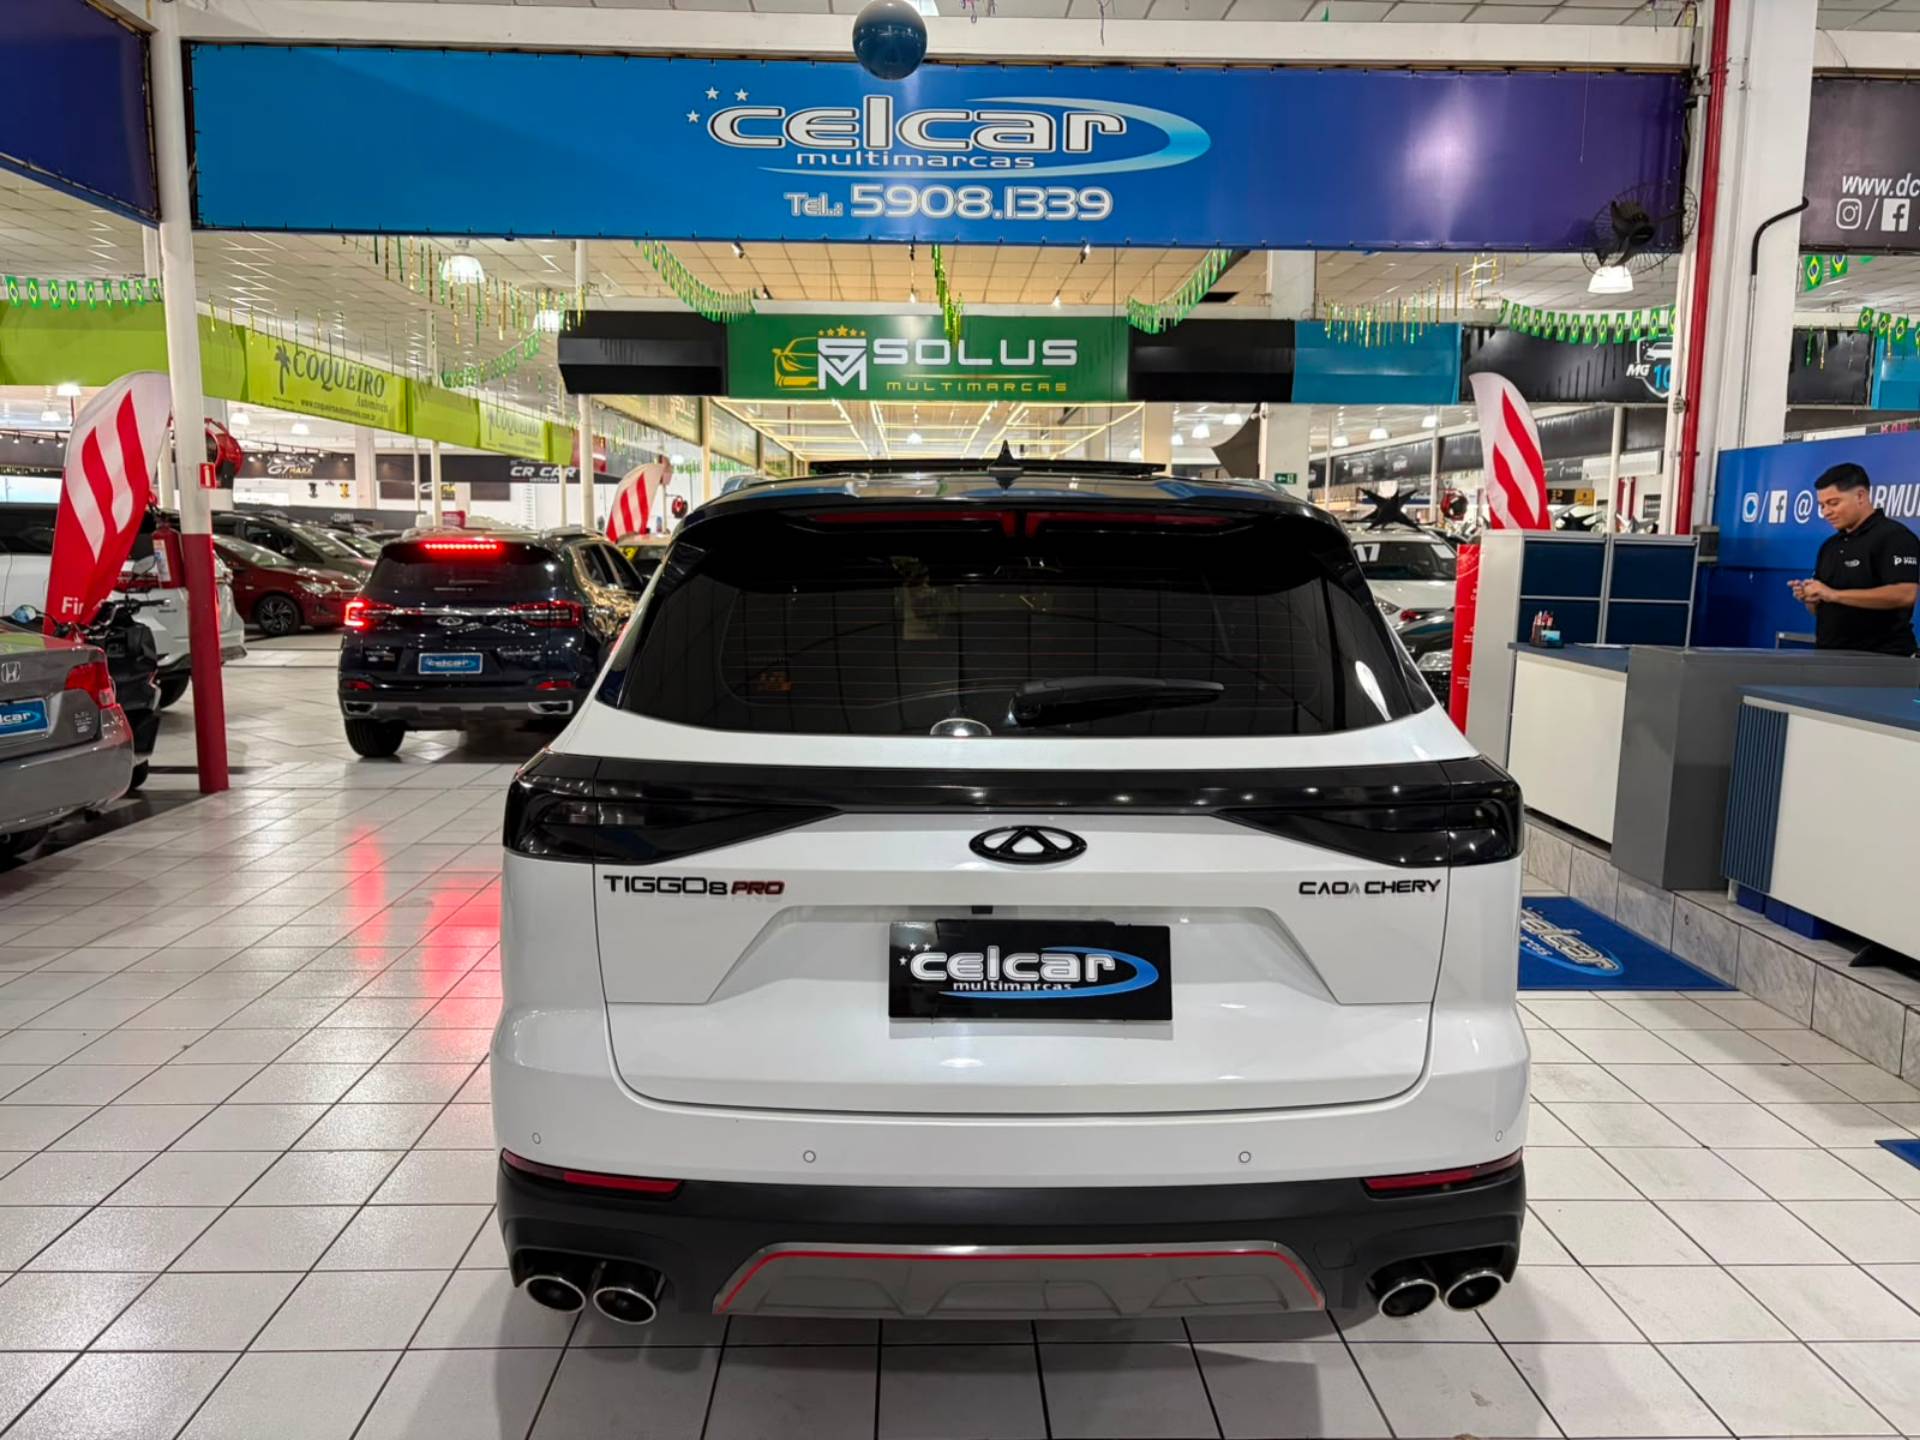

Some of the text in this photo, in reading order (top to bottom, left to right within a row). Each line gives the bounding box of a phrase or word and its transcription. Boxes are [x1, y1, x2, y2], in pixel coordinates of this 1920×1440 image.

[707, 95, 1127, 153] celcar
[796, 150, 1035, 169] multimarcas
[850, 183, 1114, 221] 5908.1339
[873, 338, 1078, 366] SOLUS
[293, 350, 386, 399] COQUEIRO
[1625, 363, 1651, 377] MG
[886, 381, 1069, 392] MULTIMARCAS
[510, 466, 577, 478] CR CAR
[731, 880, 785, 896] PRO
[1364, 879, 1441, 895] CHERY
[910, 945, 1116, 982] celcar
[953, 980, 1072, 992] multimarcas
